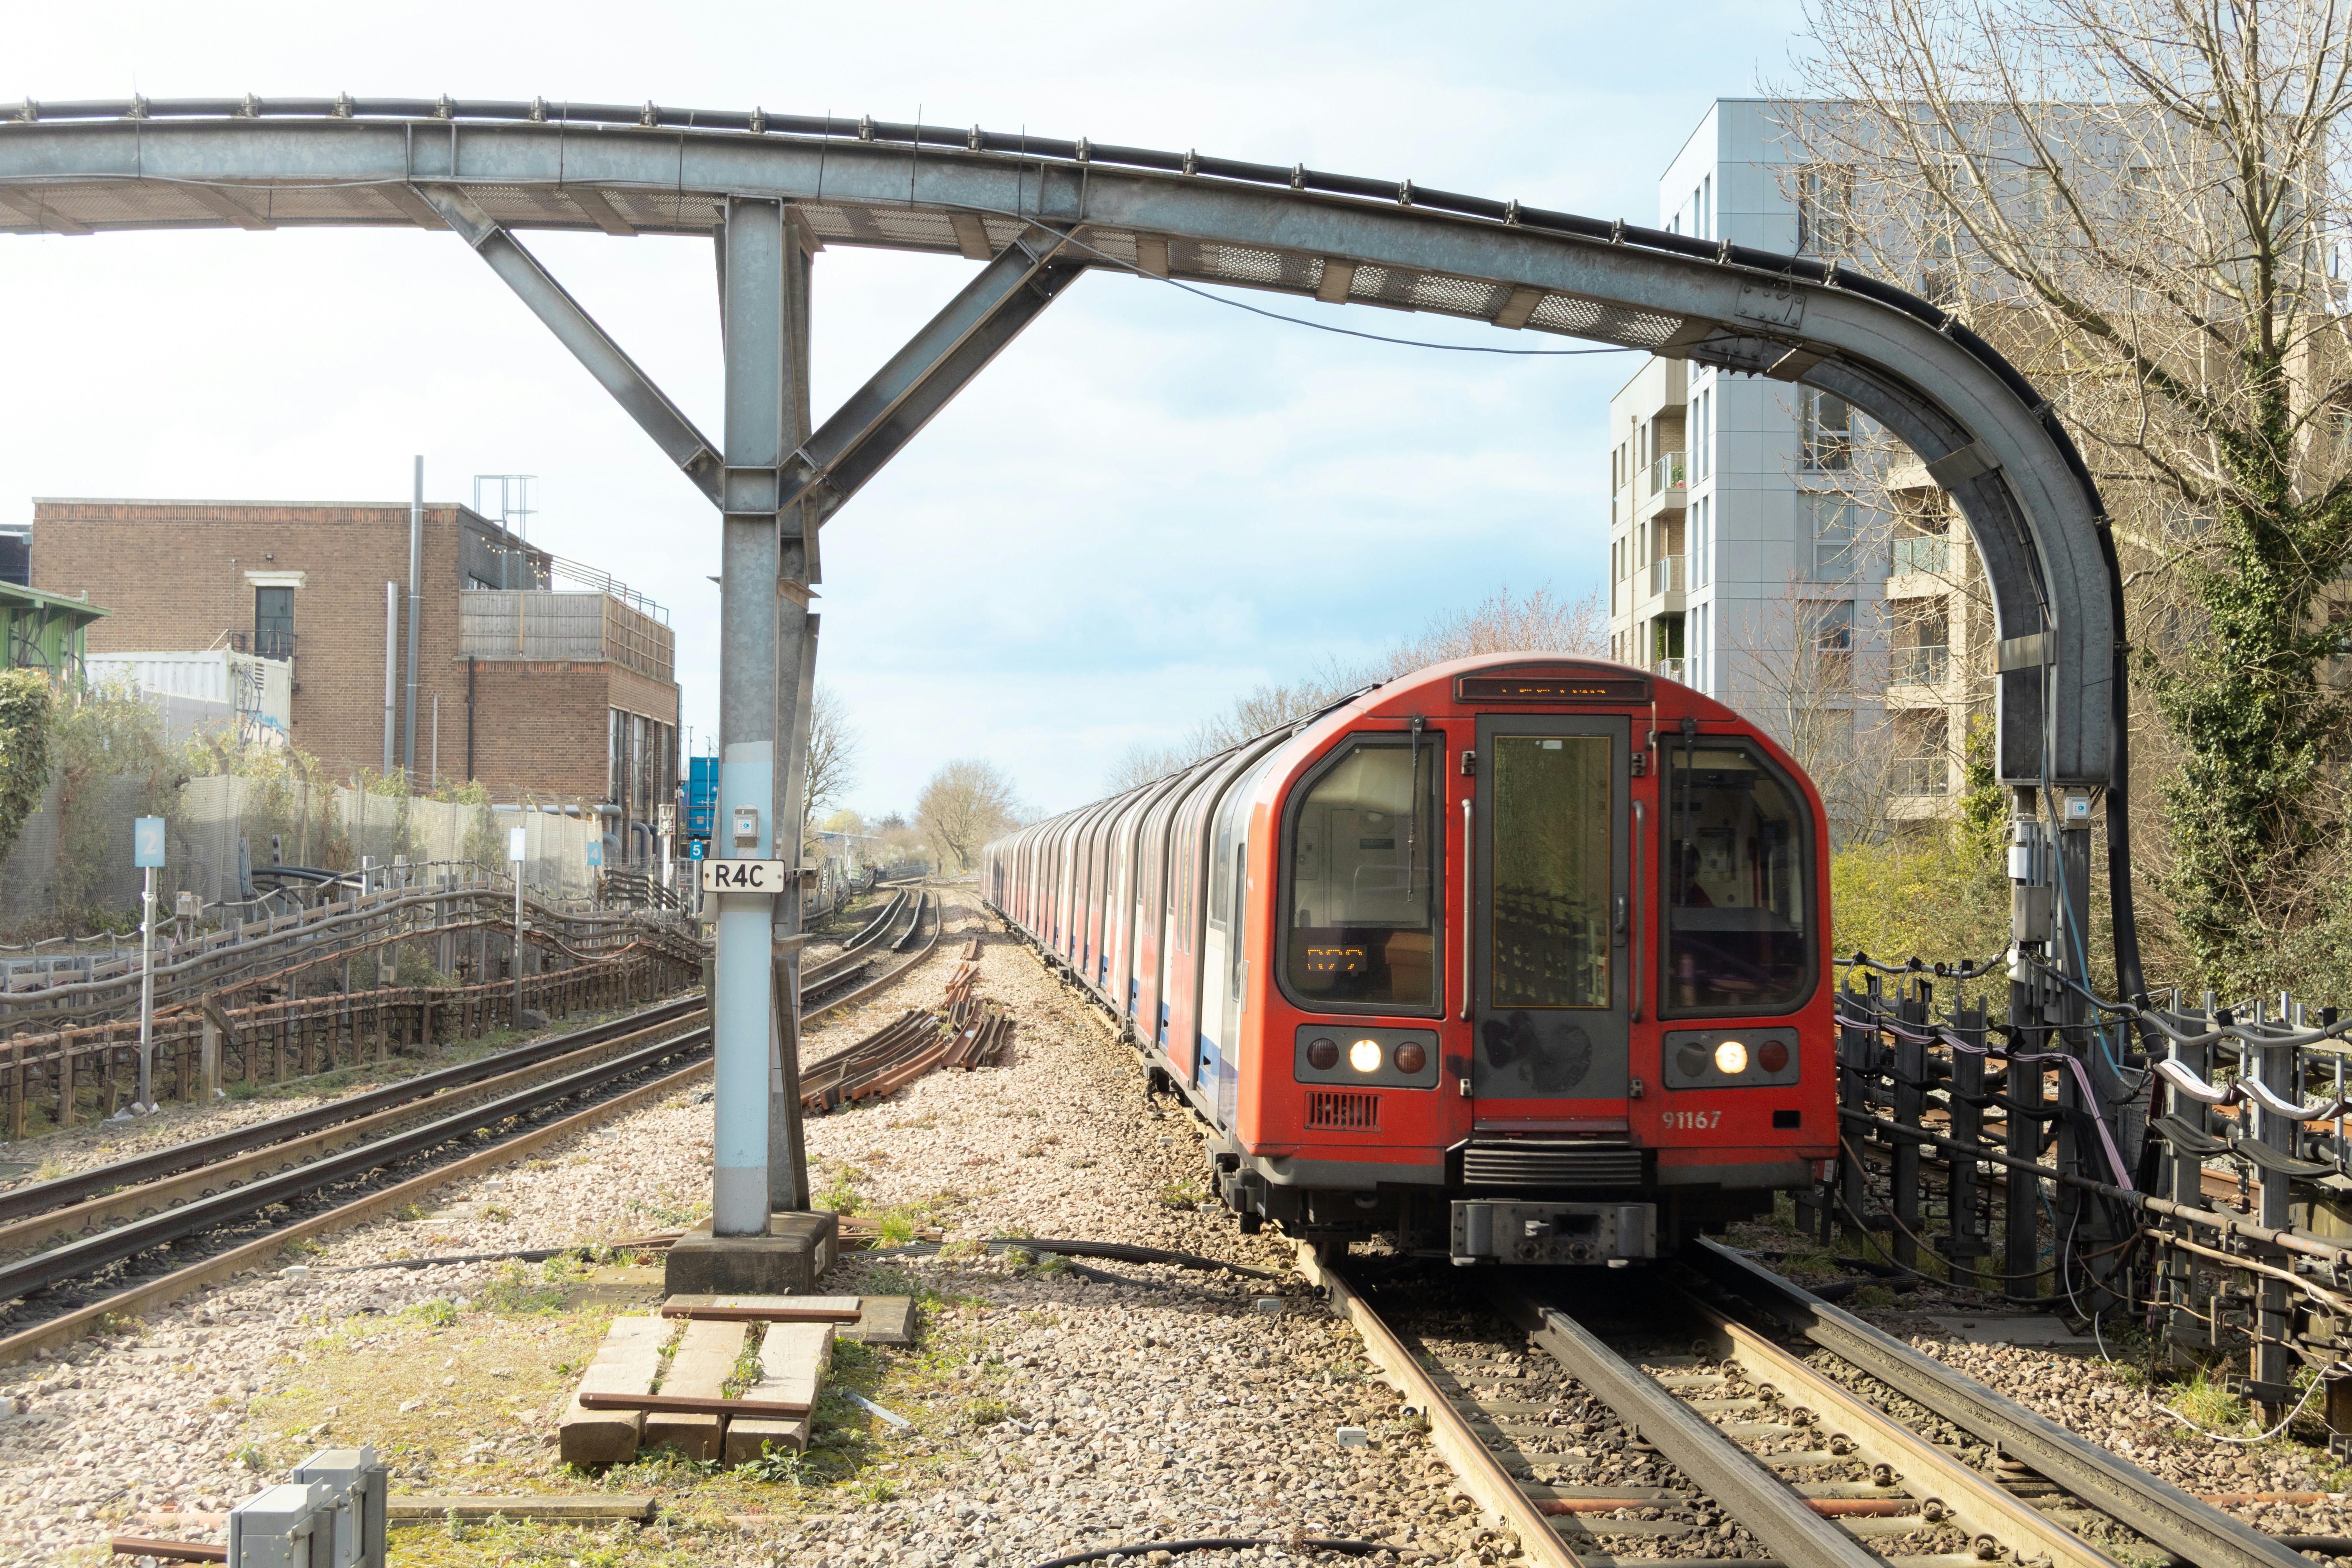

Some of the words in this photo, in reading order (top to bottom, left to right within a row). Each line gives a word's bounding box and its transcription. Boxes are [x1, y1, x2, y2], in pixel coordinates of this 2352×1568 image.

[143, 831, 157, 854] 2
[692, 845, 701, 856] 5
[591, 848, 598, 859] 4
[715, 864, 764, 887] R4C
[1662, 1111, 1722, 1130] 91167
